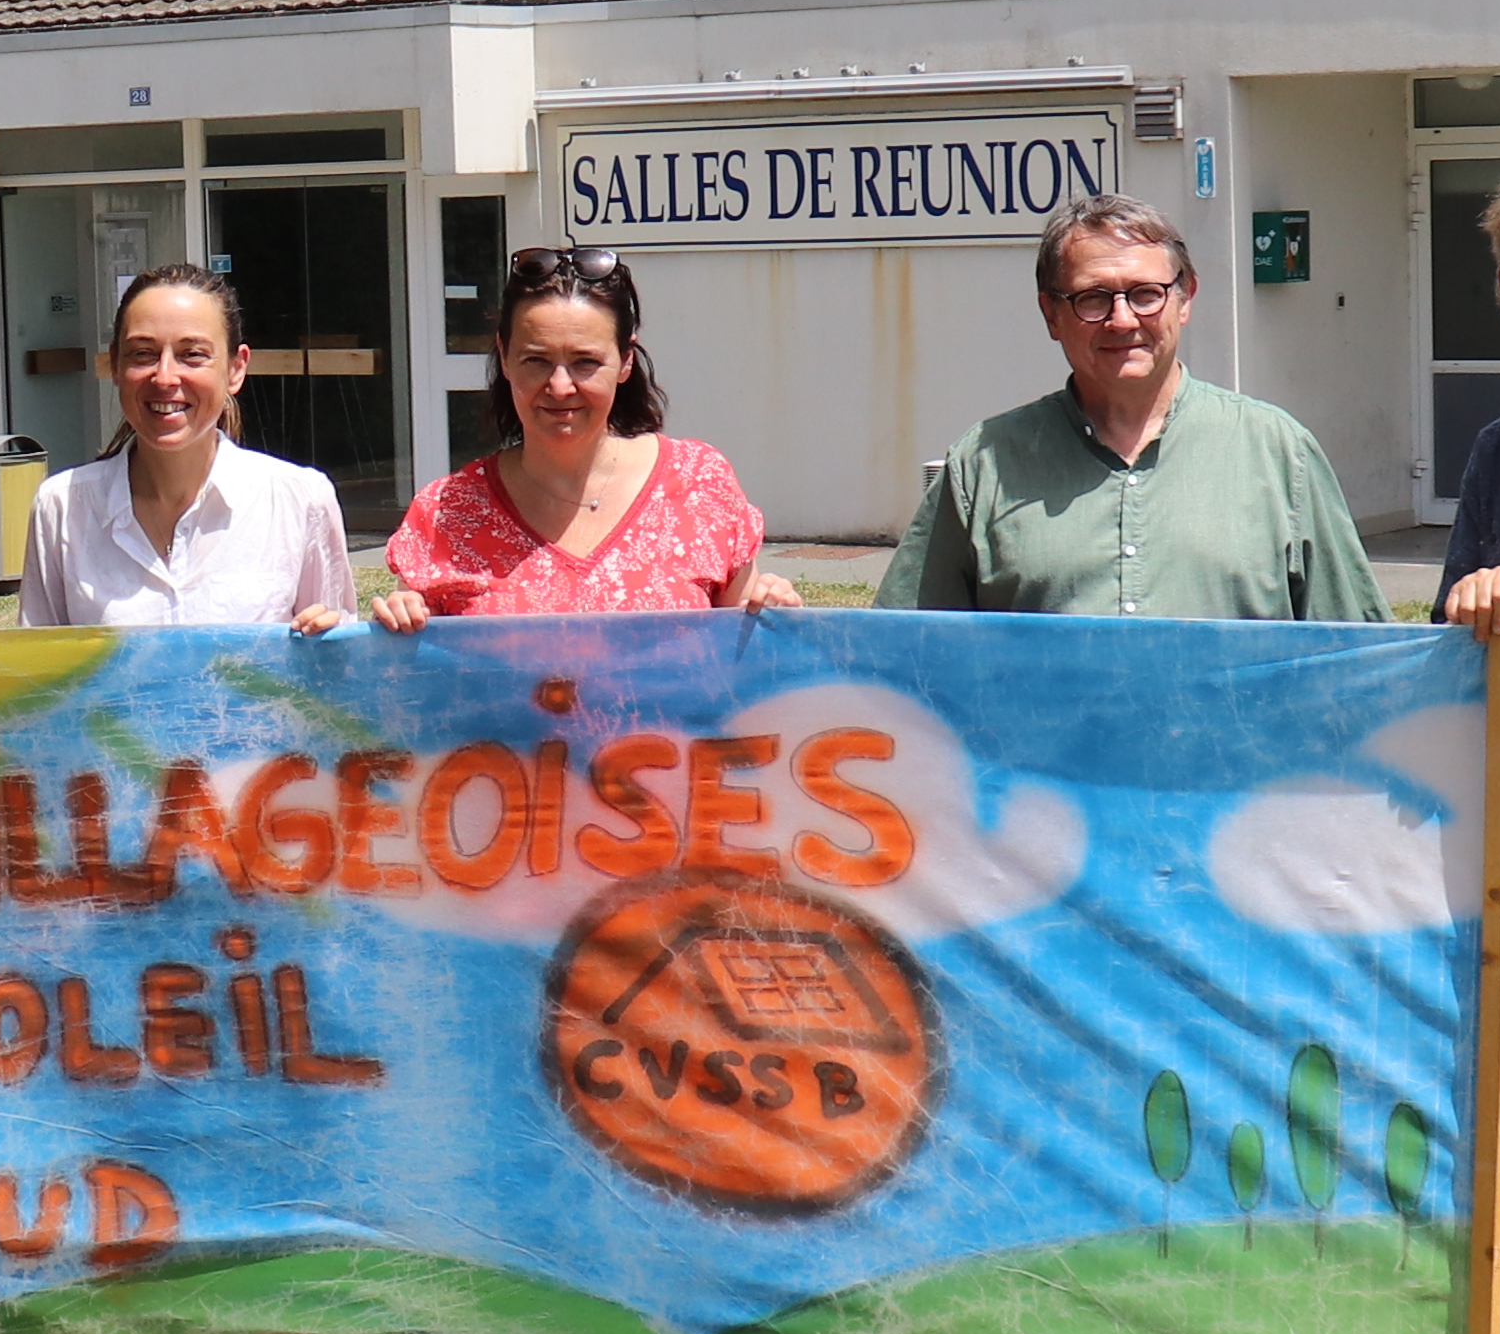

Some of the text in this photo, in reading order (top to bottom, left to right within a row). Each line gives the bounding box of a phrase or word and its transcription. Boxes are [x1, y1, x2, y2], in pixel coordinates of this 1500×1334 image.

[132, 90, 147, 102] 28
[572, 137, 1107, 226] SALLES DE REUNION
[1254, 256, 1273, 266] DAE
